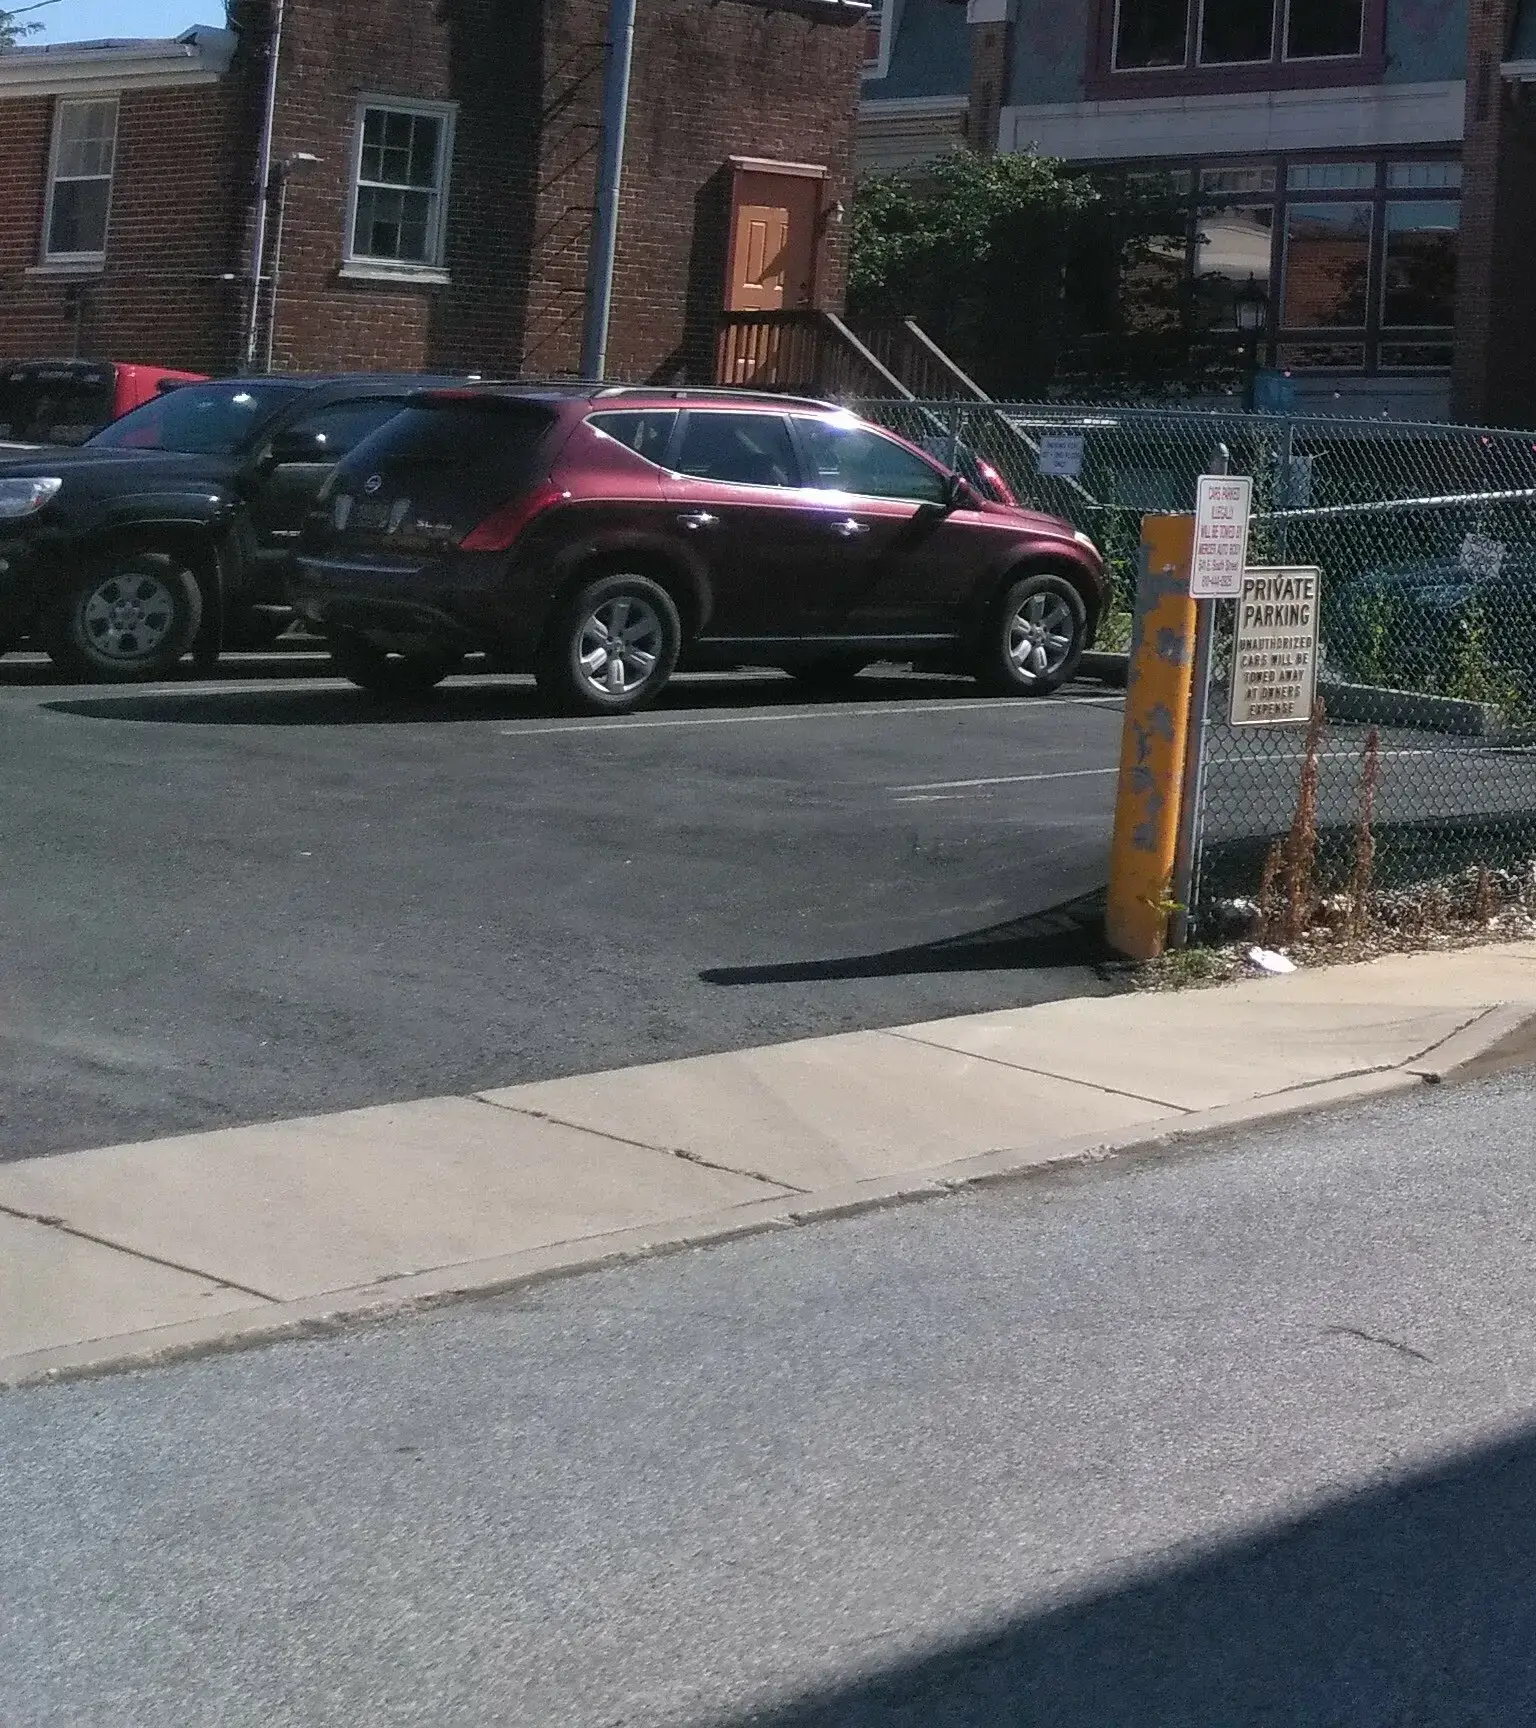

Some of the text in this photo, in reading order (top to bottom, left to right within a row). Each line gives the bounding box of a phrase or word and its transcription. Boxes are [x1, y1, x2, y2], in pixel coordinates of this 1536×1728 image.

[1243, 577, 1314, 602] PRIVATE
[1244, 603, 1310, 629] PARKING
[1239, 635, 1313, 651] UNAUTHORIZED
[1241, 652, 1309, 668] CARS WILL BE
[1244, 668, 1305, 684] TOWED AWAY
[1245, 684, 1301, 700] AT OWNERS
[1250, 701, 1295, 716] EXPENSE
